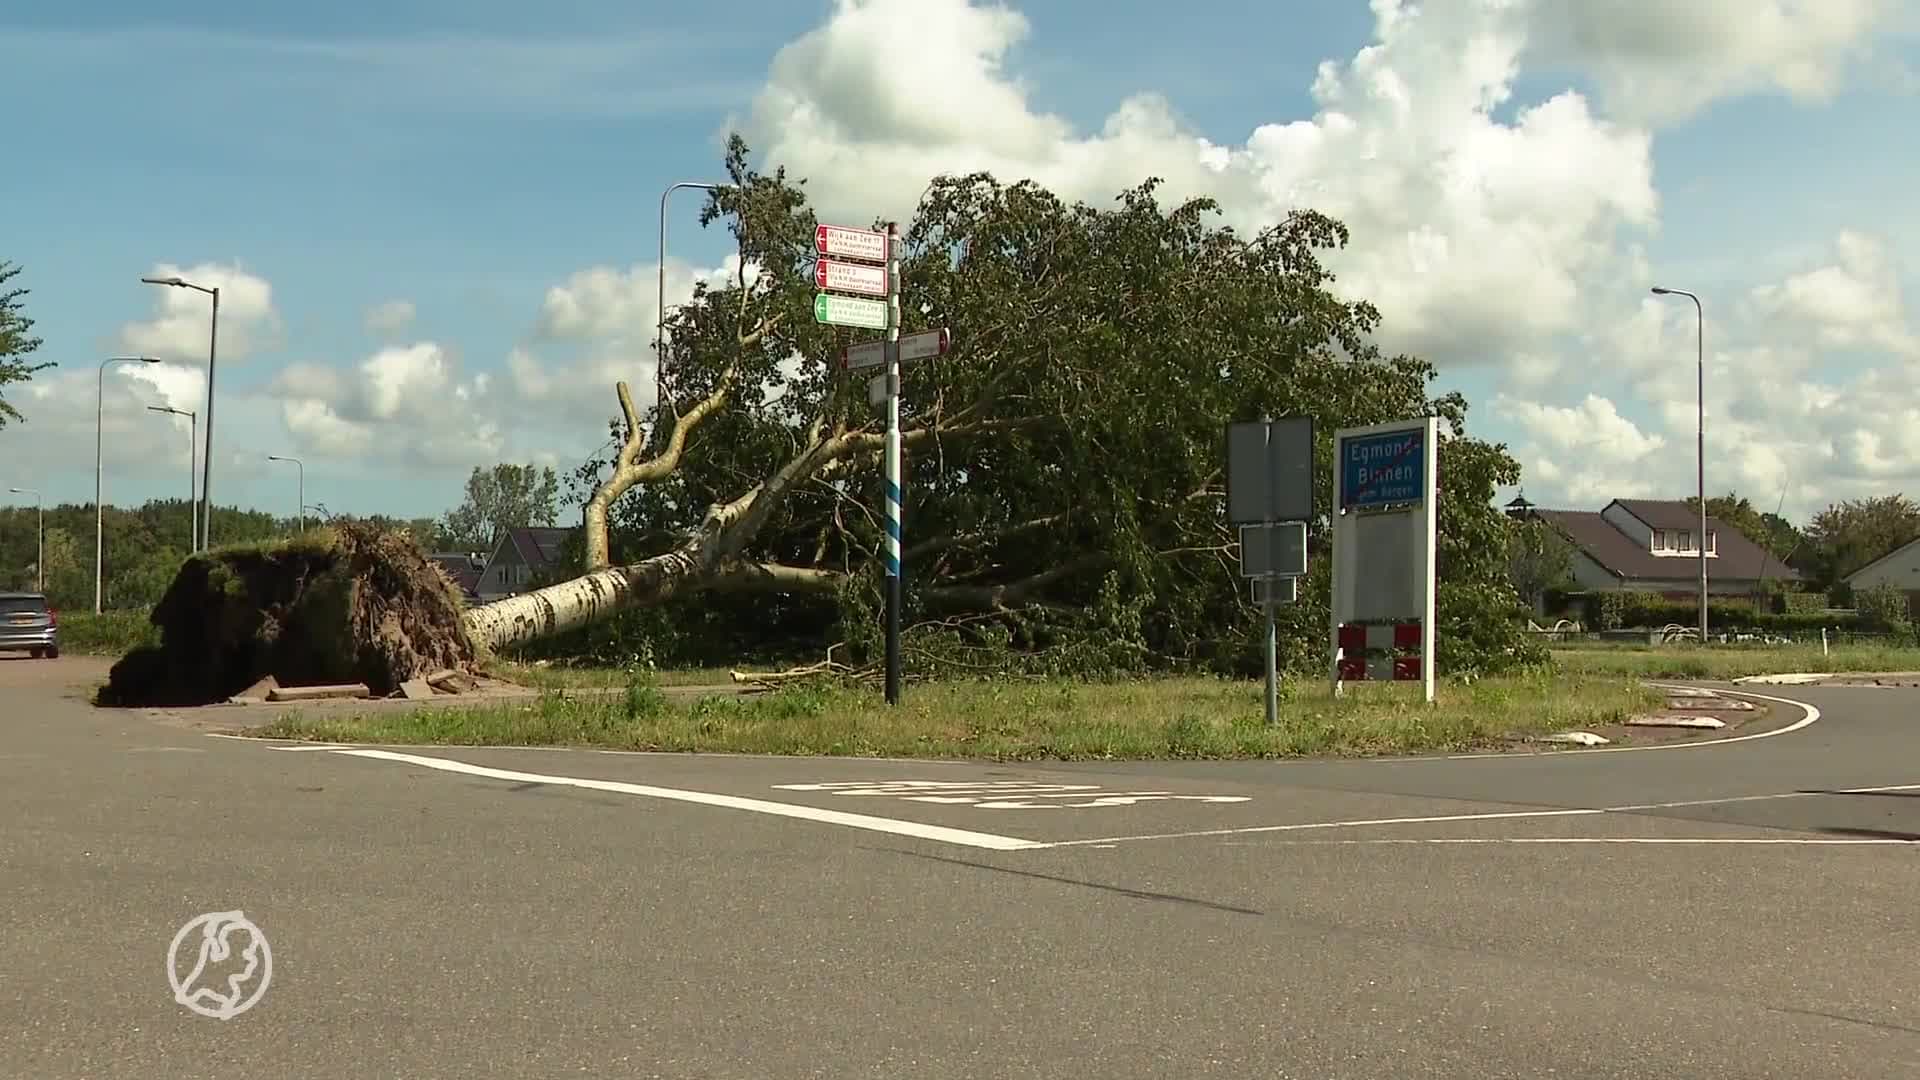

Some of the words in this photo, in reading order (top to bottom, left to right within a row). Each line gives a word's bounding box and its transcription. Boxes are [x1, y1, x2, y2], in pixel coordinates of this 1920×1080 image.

[845, 233, 858, 241] aan
[860, 233, 872, 243] Zee
[828, 264, 850, 275] Strand
